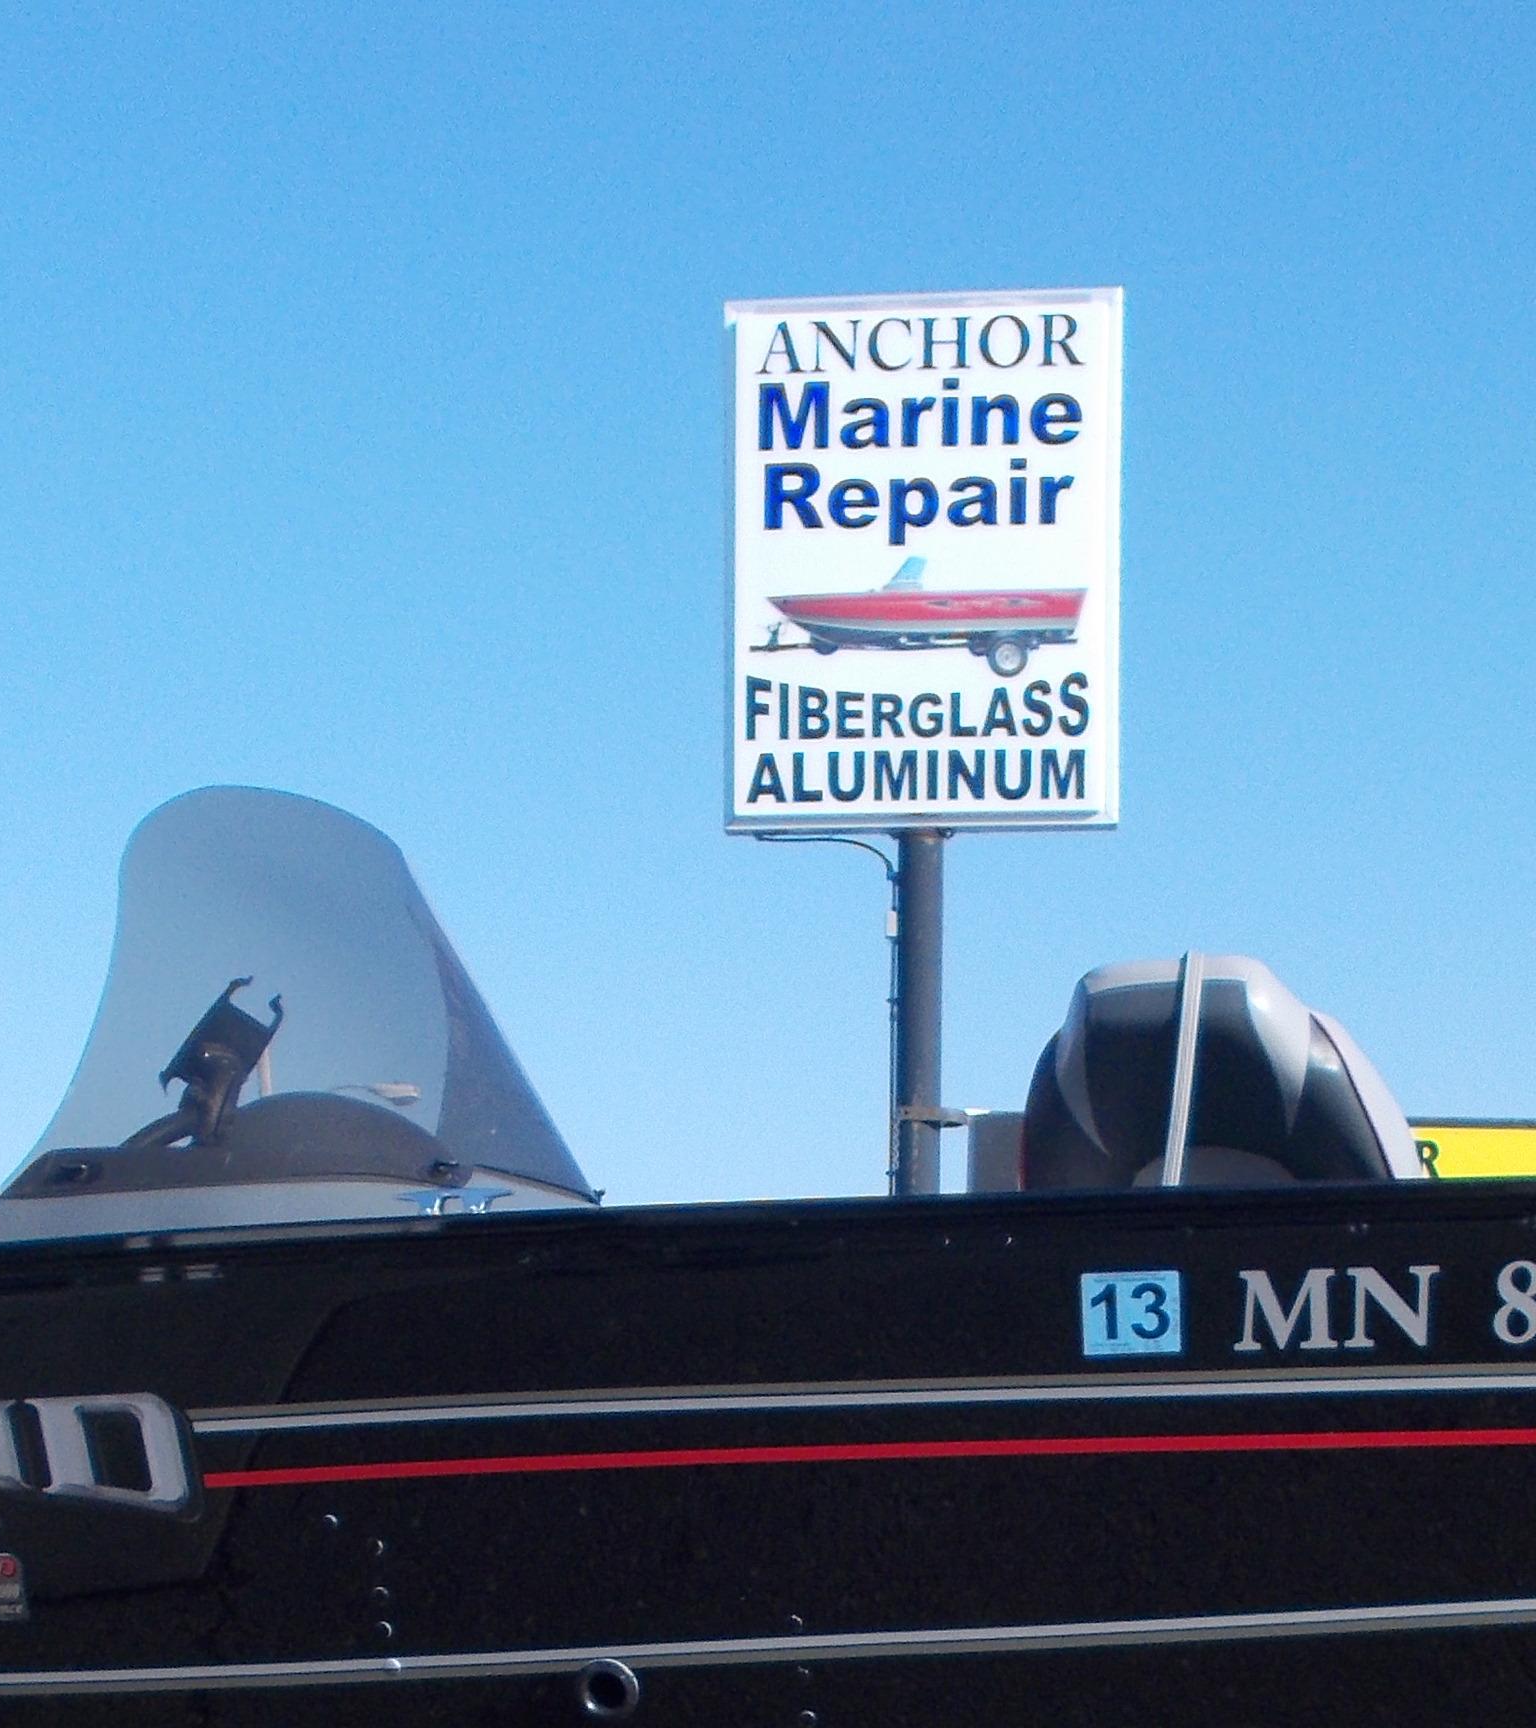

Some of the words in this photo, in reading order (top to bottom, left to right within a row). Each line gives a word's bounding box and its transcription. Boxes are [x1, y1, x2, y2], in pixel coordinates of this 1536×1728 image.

[755, 312, 1087, 375] ANCHOR
[758, 376, 1083, 451] Marine
[763, 457, 1075, 546] Repair
[745, 671, 1089, 740] FIBERGLASS
[746, 749, 1086, 804] ALUMINUM
[1090, 1282, 1171, 1339] 13
[1233, 1264, 1441, 1353] MN
